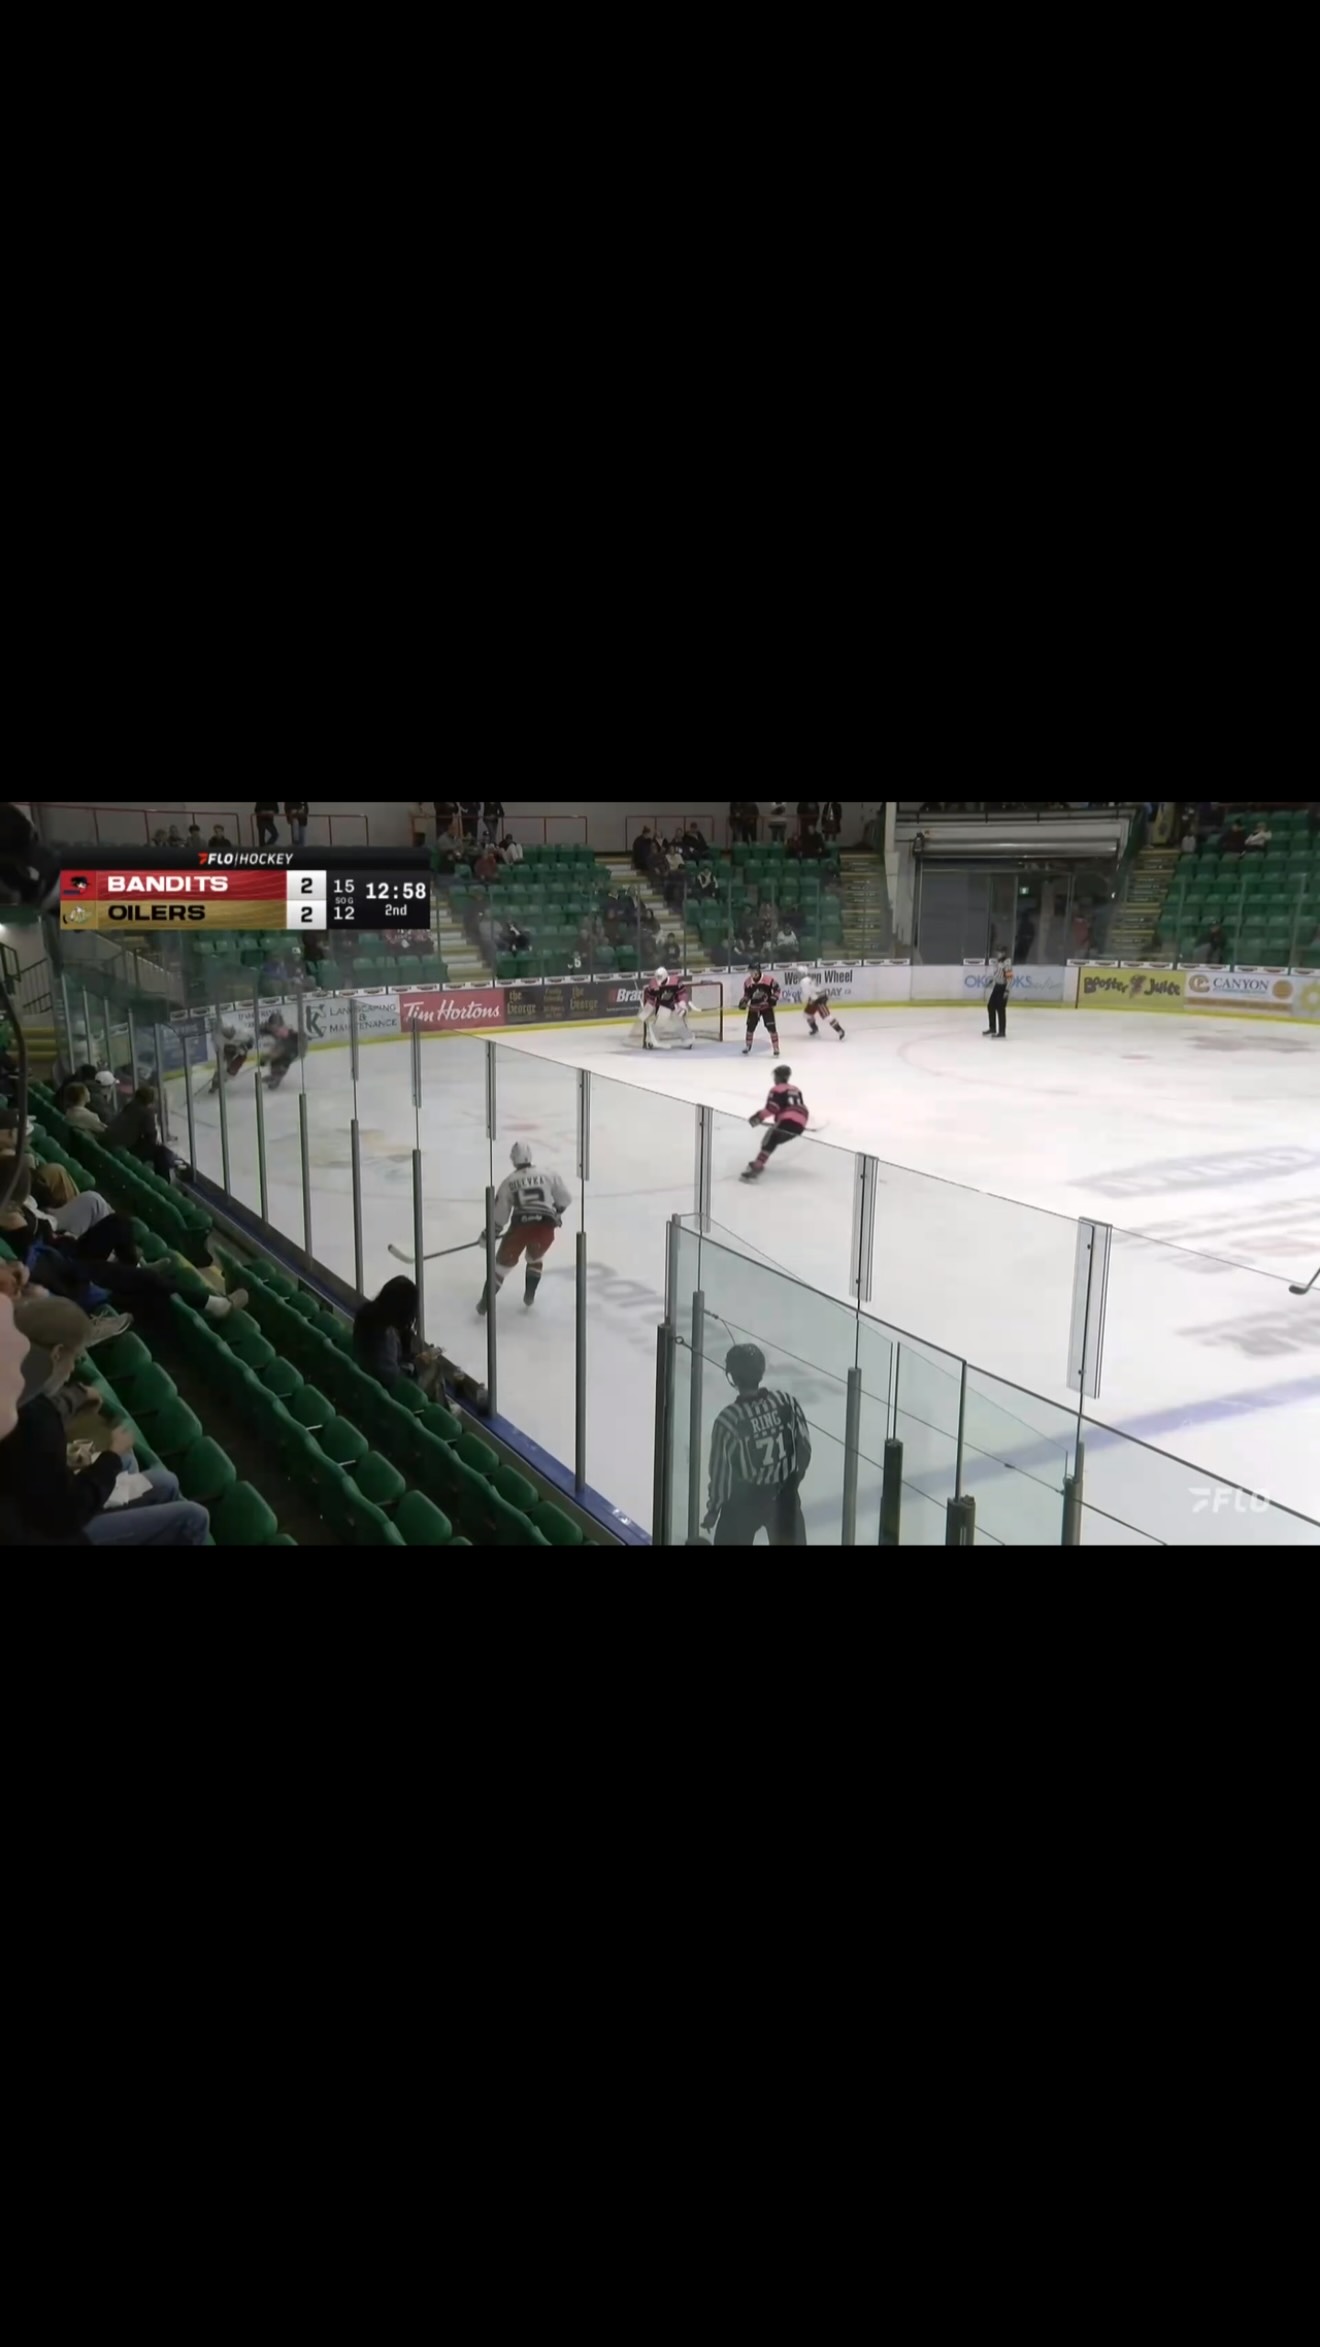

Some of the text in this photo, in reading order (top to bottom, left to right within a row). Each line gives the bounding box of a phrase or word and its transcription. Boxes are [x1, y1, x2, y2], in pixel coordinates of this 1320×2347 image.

[823, 969, 853, 984] Wheel
[1084, 976, 1129, 994] Booster
[1144, 978, 1181, 996] Juice
[1212, 977, 1269, 991] CANYON
[403, 999, 501, 1022] Tim Hortons
[751, 1411, 782, 1433] RING
[755, 1432, 787, 1466] 71
